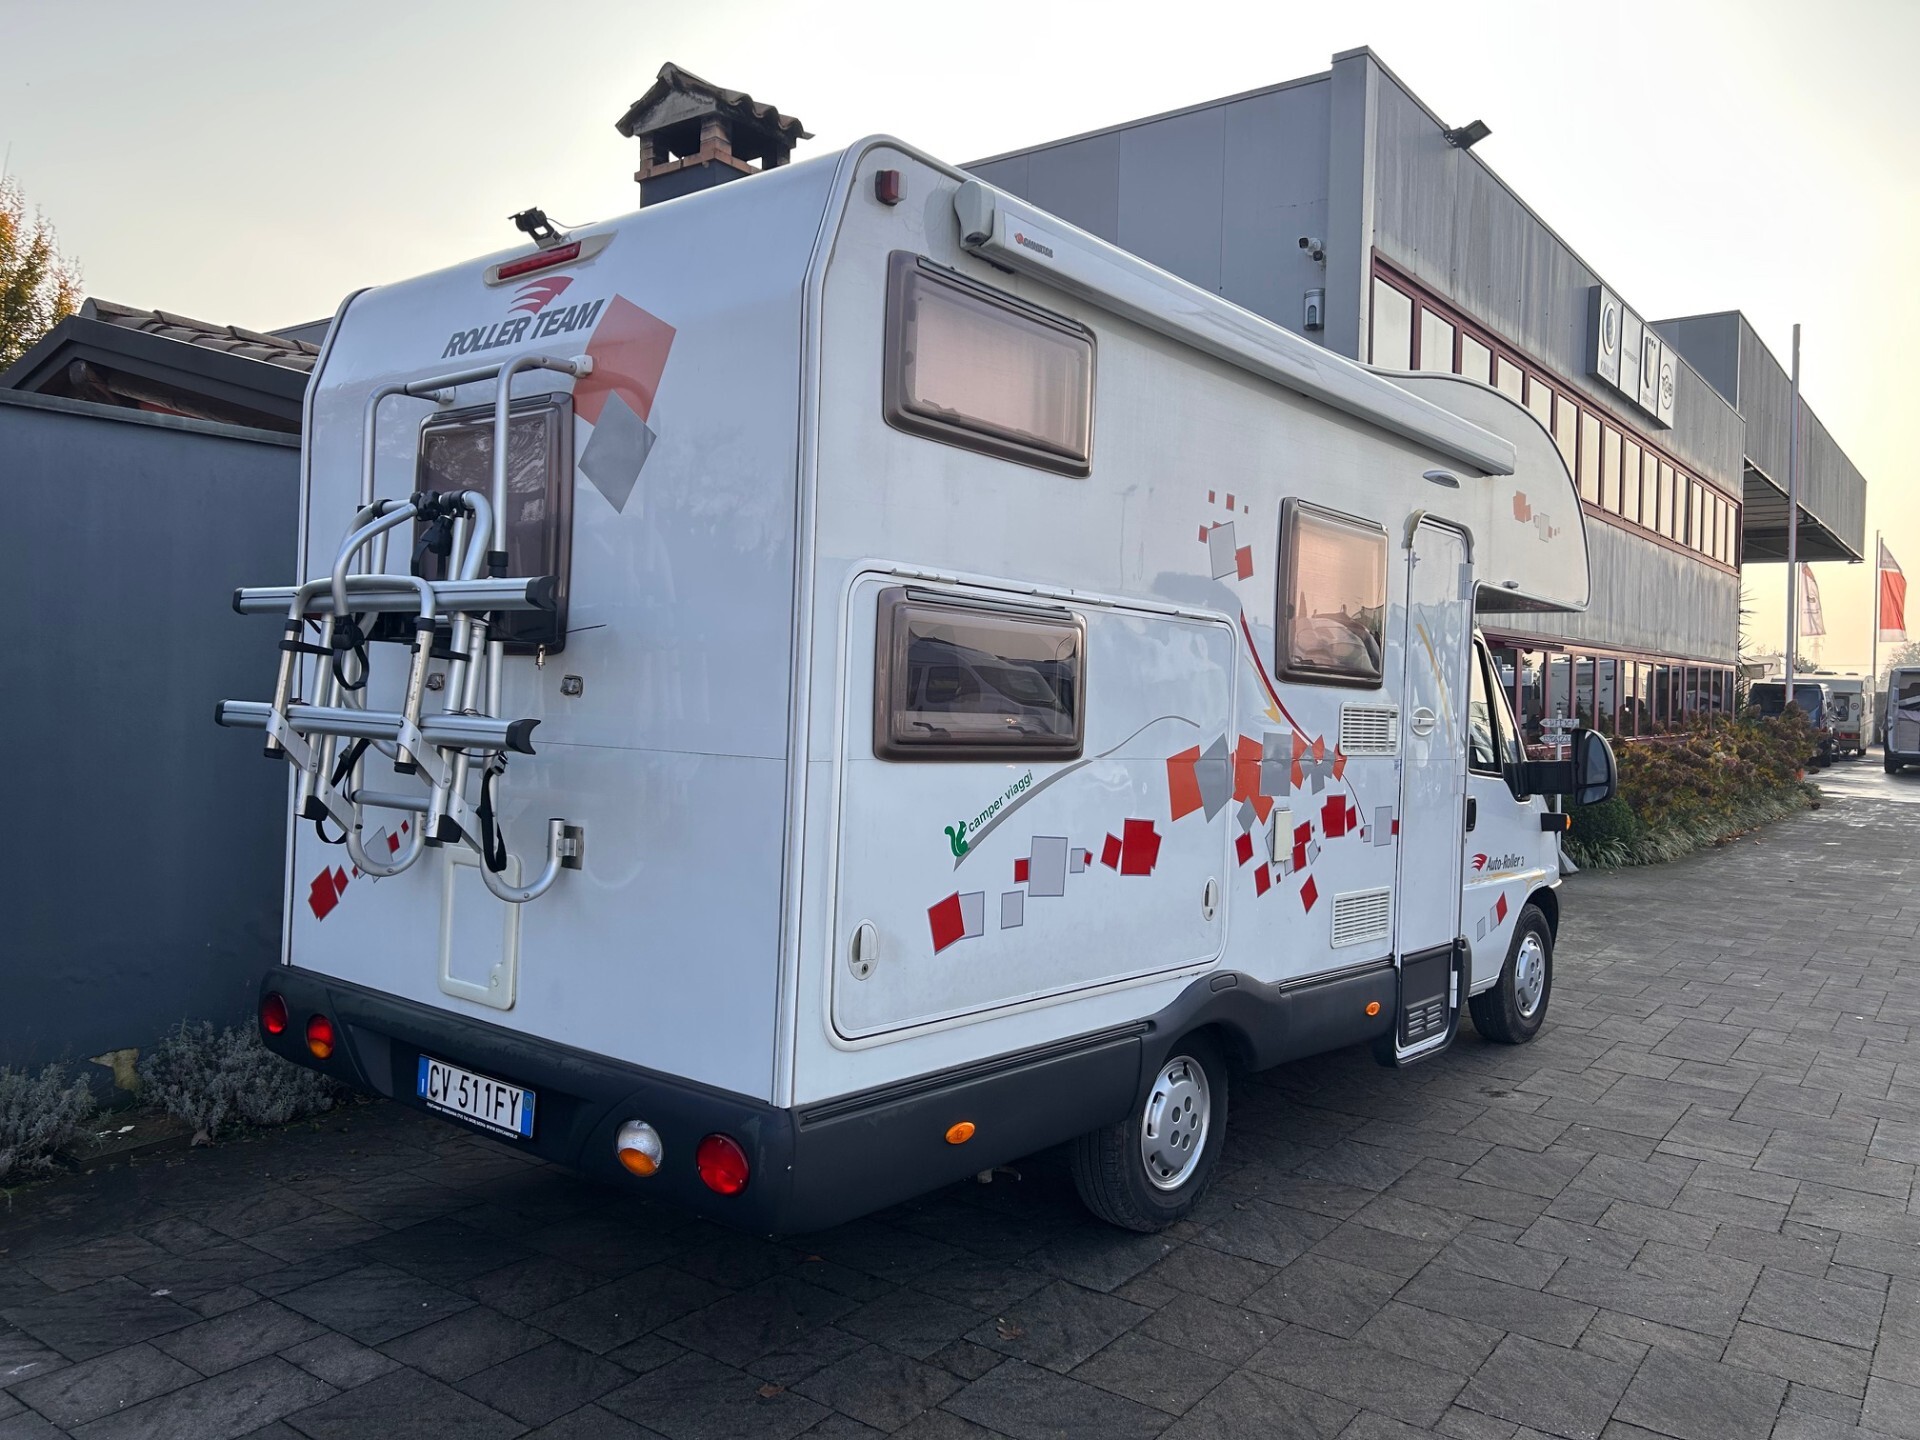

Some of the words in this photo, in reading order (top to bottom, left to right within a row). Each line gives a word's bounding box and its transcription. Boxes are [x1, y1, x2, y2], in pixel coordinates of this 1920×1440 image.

[441, 316, 532, 359] ROLLER
[530, 299, 605, 340] TEAM
[968, 796, 1003, 833] camper
[1005, 769, 1033, 800] viaggi
[1486, 853, 1520, 871] Auto-Roller
[429, 1065, 451, 1102] CV
[458, 1075, 520, 1127] 511FY
